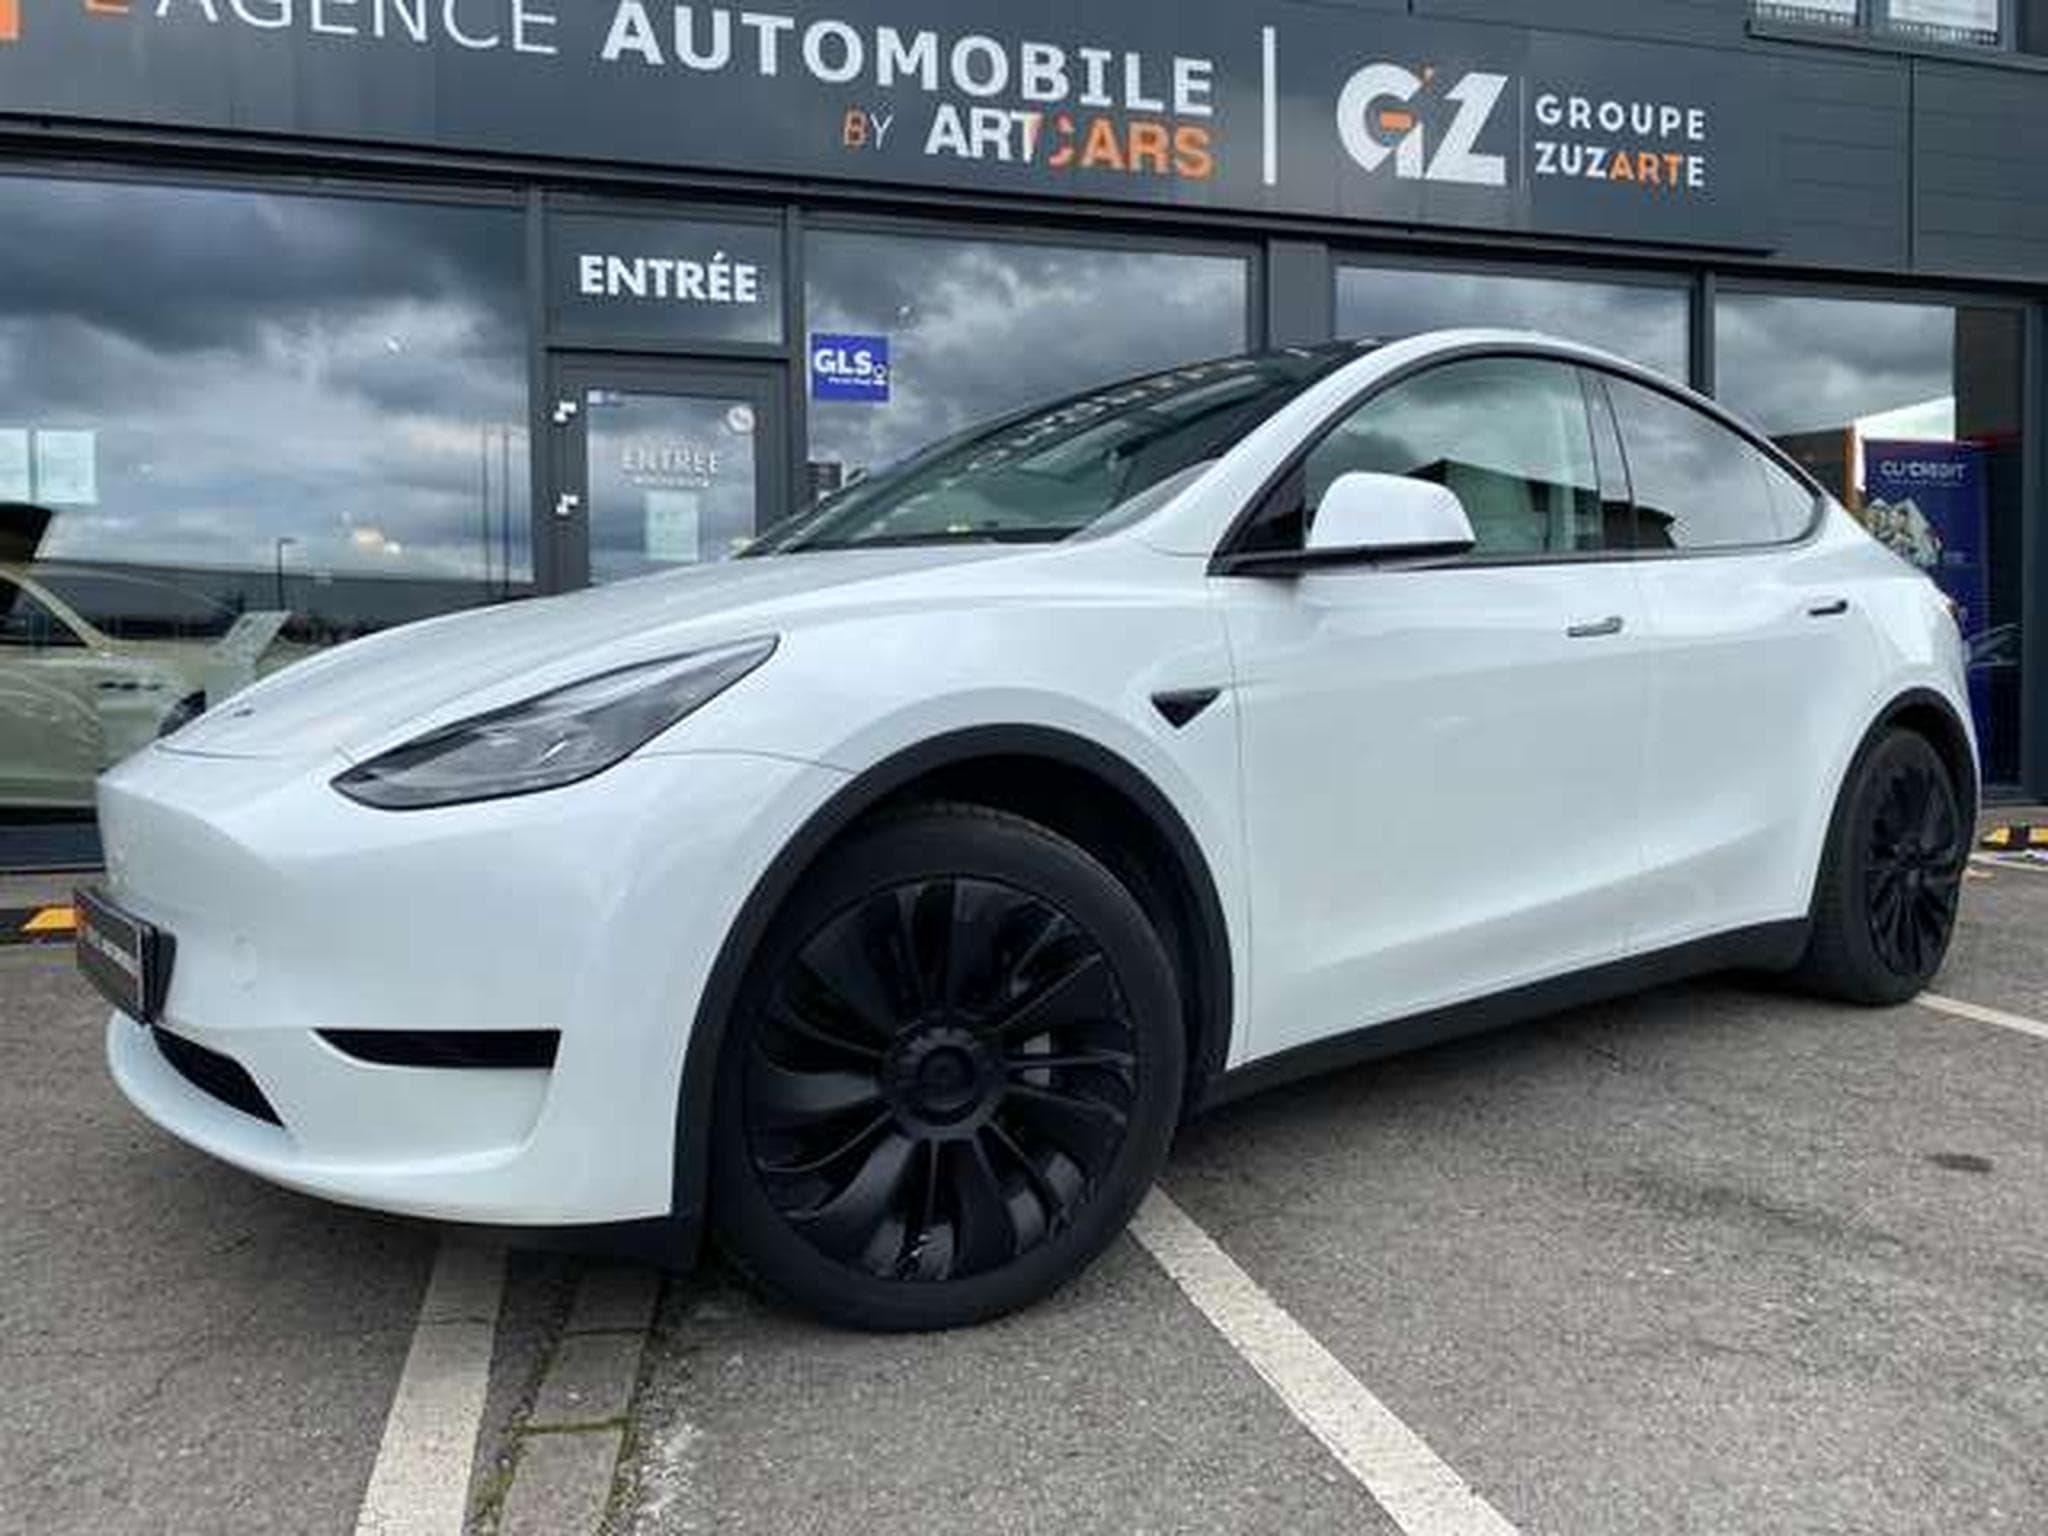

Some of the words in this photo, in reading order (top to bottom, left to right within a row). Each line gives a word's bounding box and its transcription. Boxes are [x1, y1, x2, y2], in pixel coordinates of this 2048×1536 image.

[86, 0, 558, 54] ENCE
[602, 1, 1214, 116] AUTOMOBILE
[843, 109, 893, 150] BY
[1535, 94, 1705, 140] GROUPE
[1535, 142, 1705, 187] ZUZARTE
[579, 251, 757, 302] ENTRÉE
[814, 349, 872, 375] GLS
